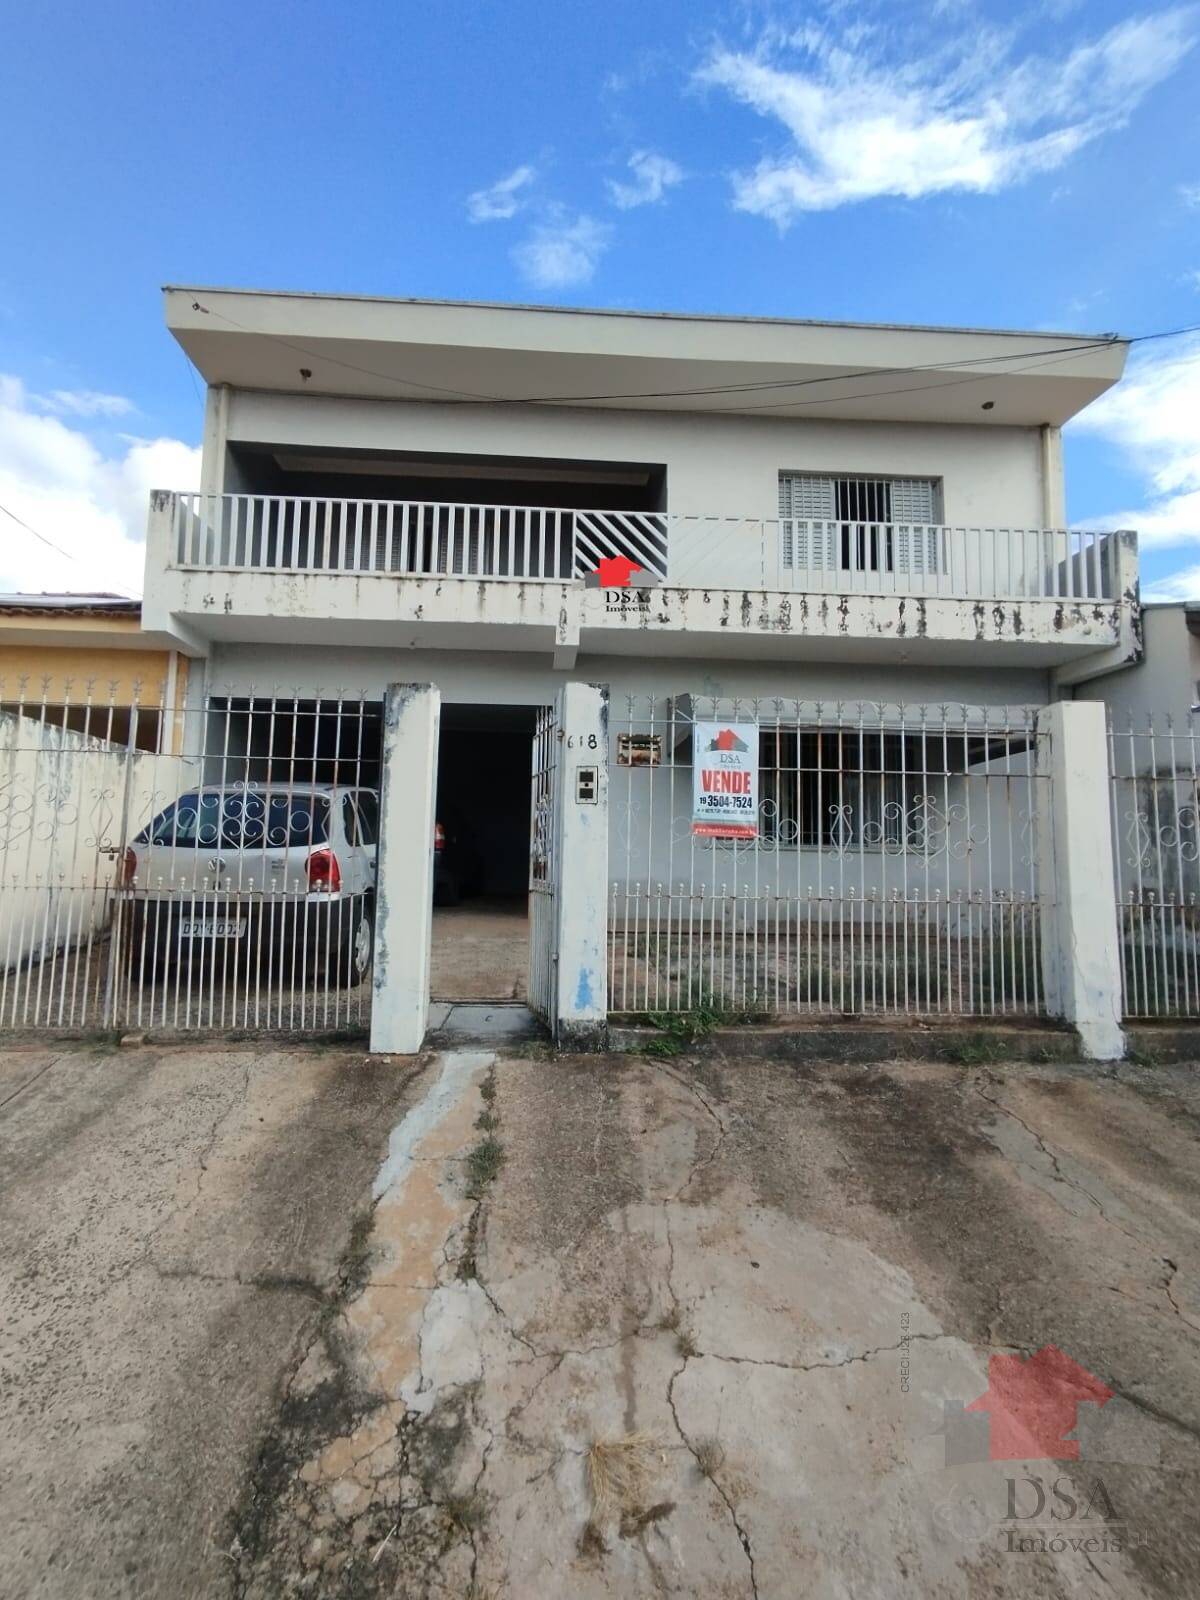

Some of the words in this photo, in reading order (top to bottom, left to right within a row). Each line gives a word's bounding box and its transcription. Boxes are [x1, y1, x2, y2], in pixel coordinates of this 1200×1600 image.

[567, 733, 597, 749] 618
[720, 753, 741, 763] DSA
[702, 769, 751, 794] VENDE
[700, 796, 707, 804] 19
[707, 795, 753, 808] 3504-7524
